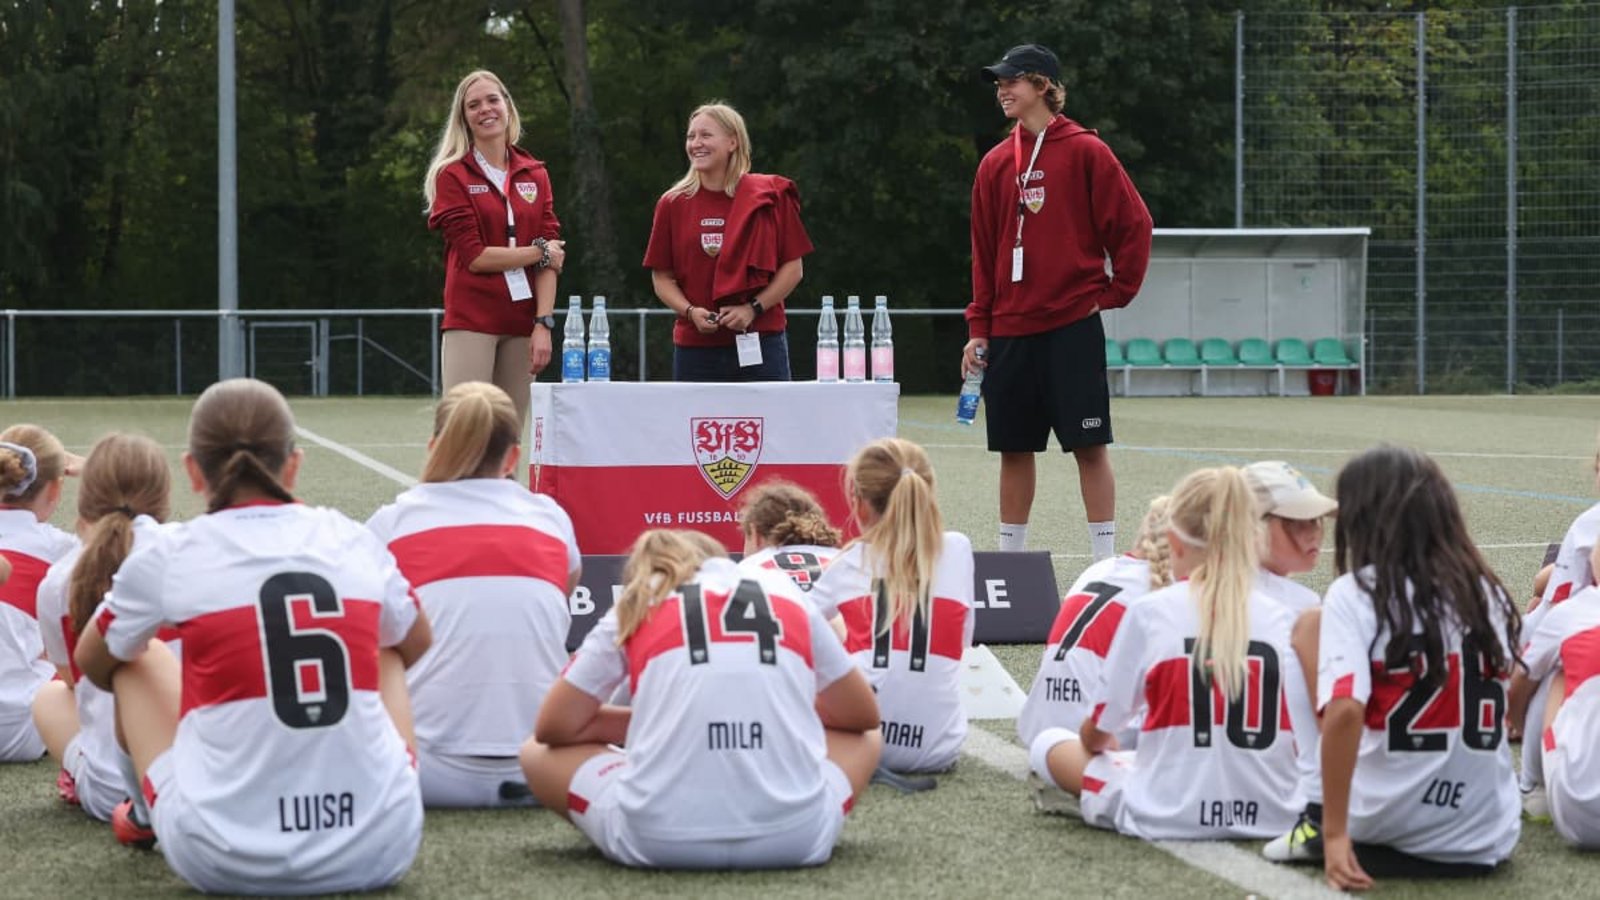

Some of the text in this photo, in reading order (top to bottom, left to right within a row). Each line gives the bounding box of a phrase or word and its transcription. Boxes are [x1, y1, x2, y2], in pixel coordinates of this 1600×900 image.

[643, 510, 742, 524] VfB FUSSBAL
[773, 551, 823, 593] 9
[257, 570, 351, 730] 6
[674, 578, 782, 666] 14
[871, 578, 930, 673] 11
[1053, 580, 1124, 662] 7
[1045, 677, 1082, 703] THEA
[1183, 636, 1281, 751] 10
[1386, 631, 1508, 753] 26
[708, 721, 763, 750] MILA
[278, 791, 355, 832] LUISA
